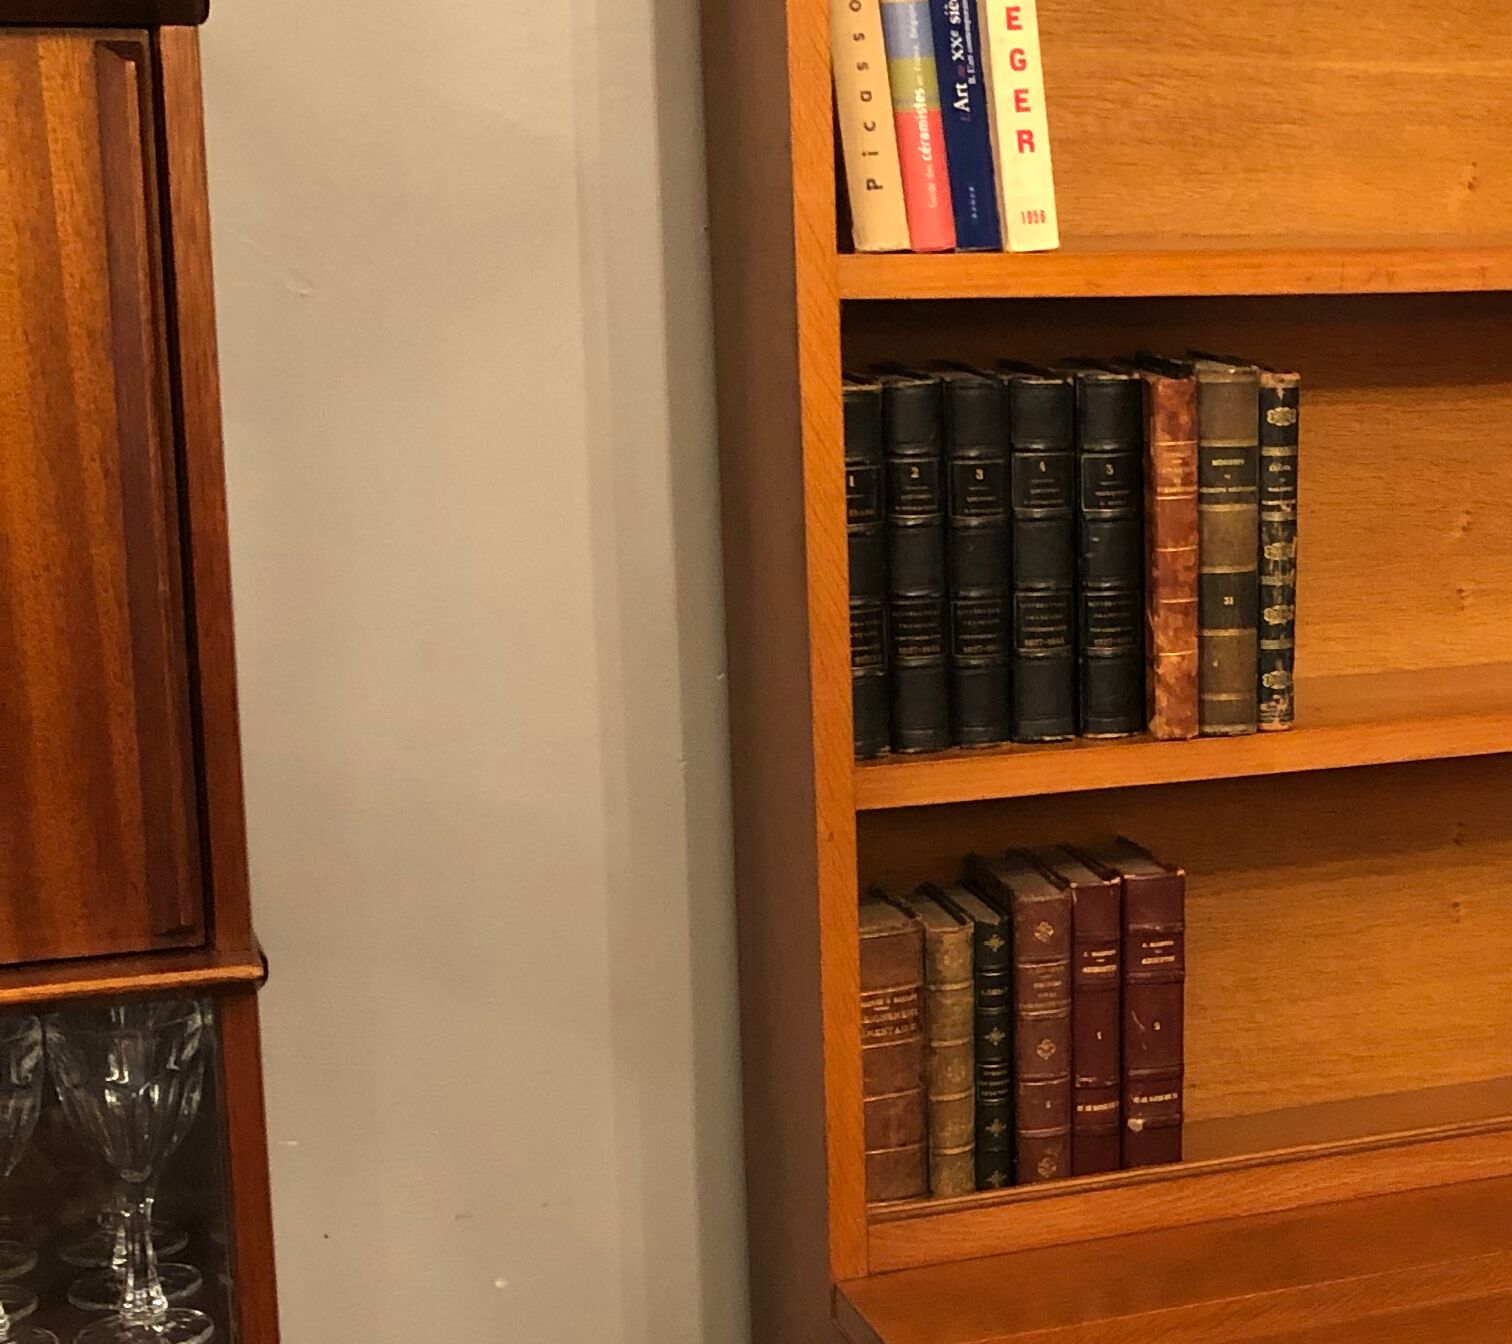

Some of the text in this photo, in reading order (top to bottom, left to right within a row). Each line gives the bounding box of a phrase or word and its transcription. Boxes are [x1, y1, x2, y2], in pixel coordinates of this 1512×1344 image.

[914, 87, 933, 161] céramistes
[910, 466, 920, 479] 2
[974, 468, 984, 481] 3
